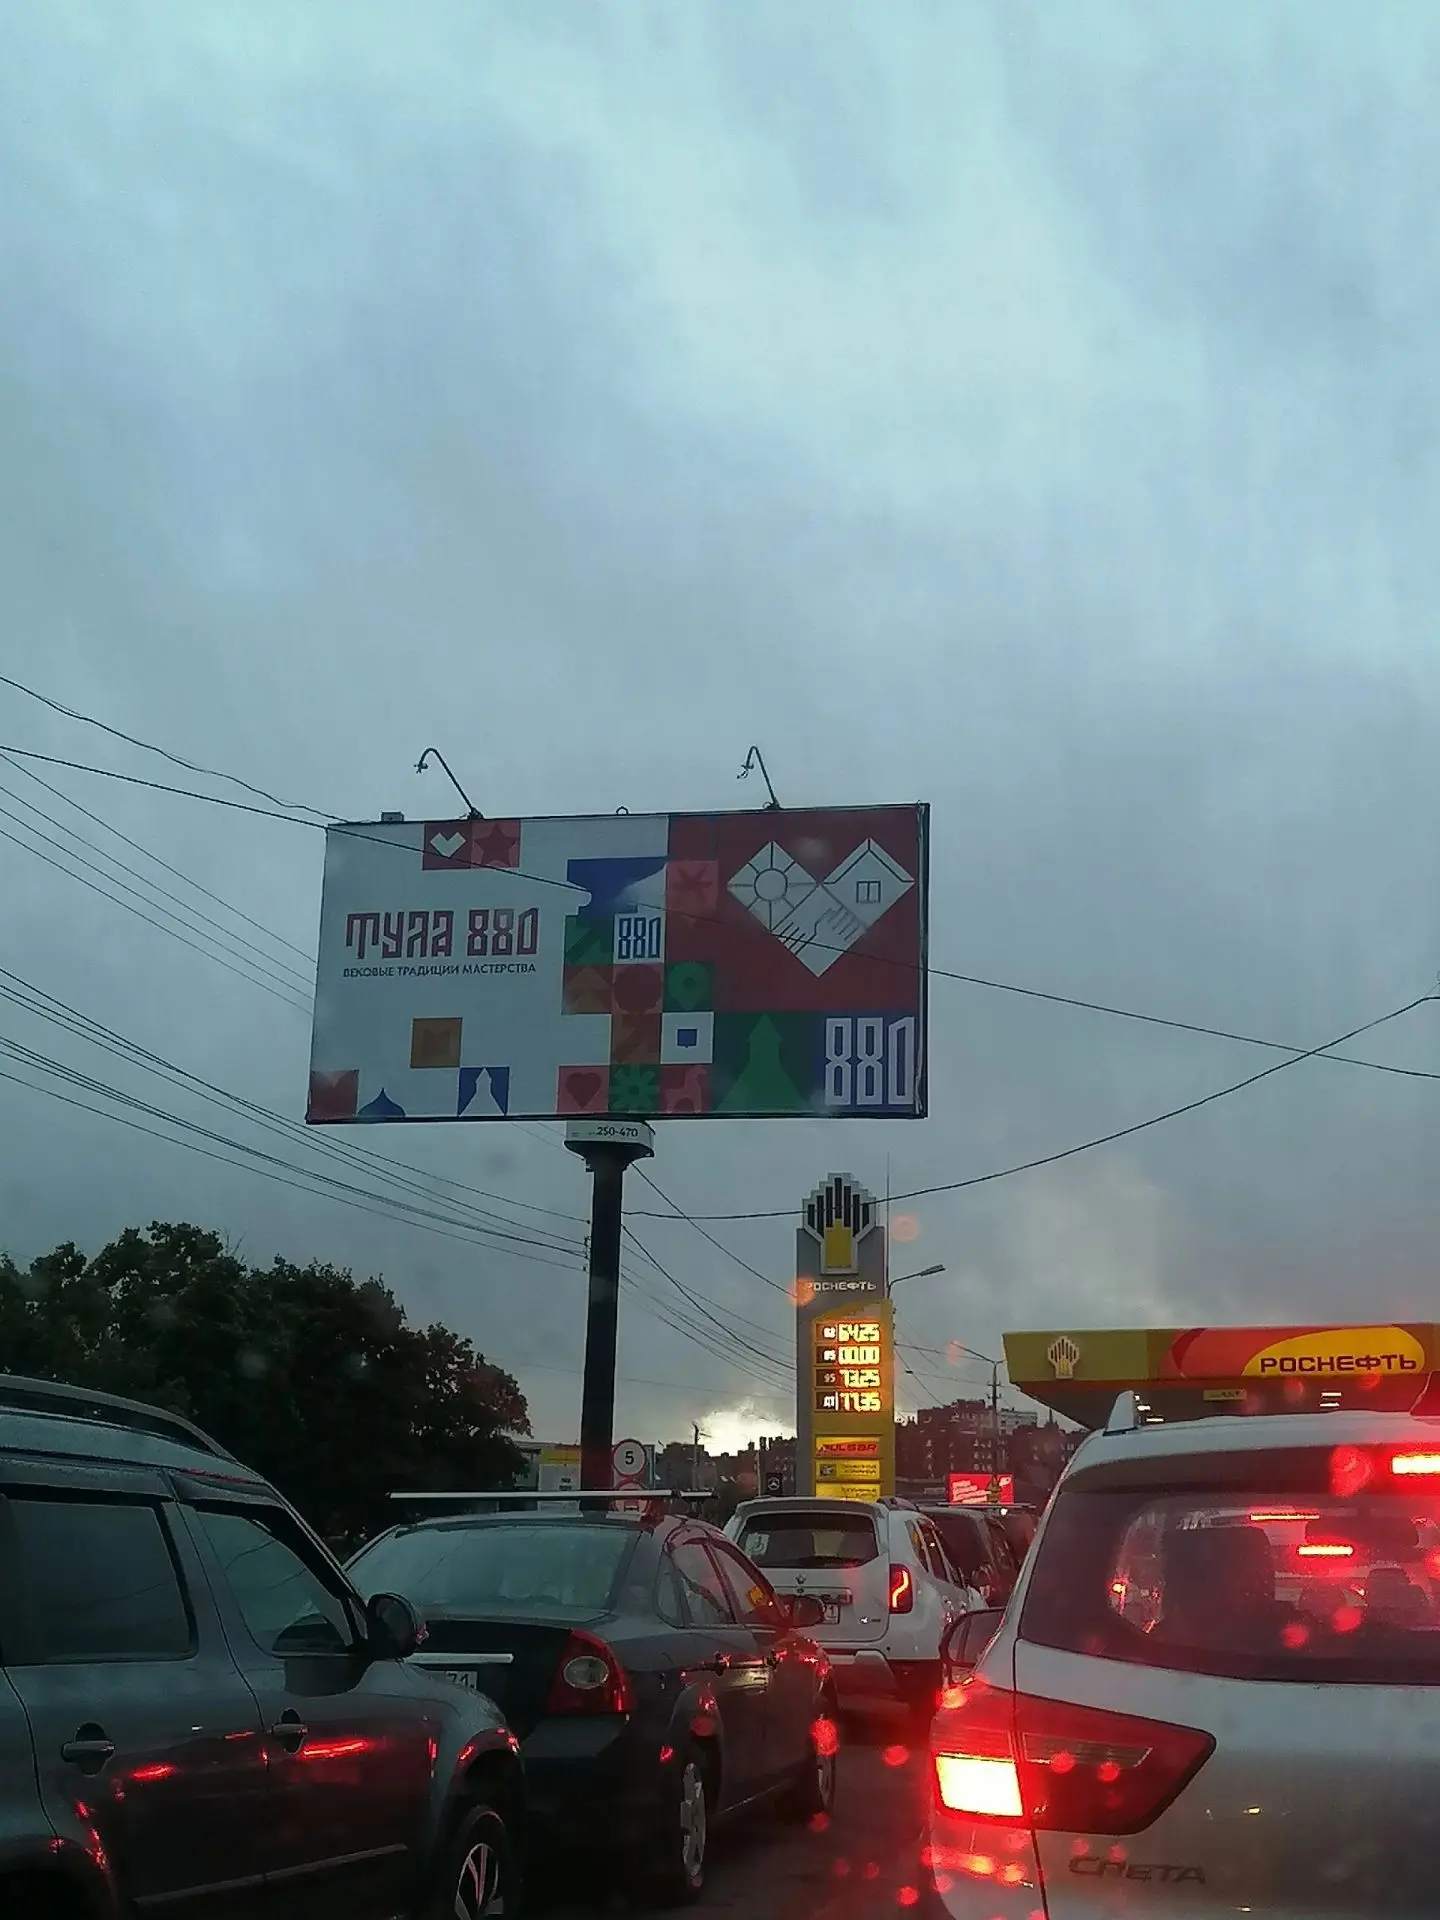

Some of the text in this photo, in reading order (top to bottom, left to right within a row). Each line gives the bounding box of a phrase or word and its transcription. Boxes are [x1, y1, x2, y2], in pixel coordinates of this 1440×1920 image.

[467, 907, 540, 956] 880
[618, 917, 661, 959] 880
[343, 963, 536, 978] ВЕКОВЫЕ ТРАДИЦИИ МАСТЕРСТВА
[825, 1017, 915, 1105] 880
[805, 1282, 877, 1292] РОСНЕФТЬ
[1260, 1355, 1417, 1373] РОСНЕФТЬ
[624, 1450, 635, 1465] 5
